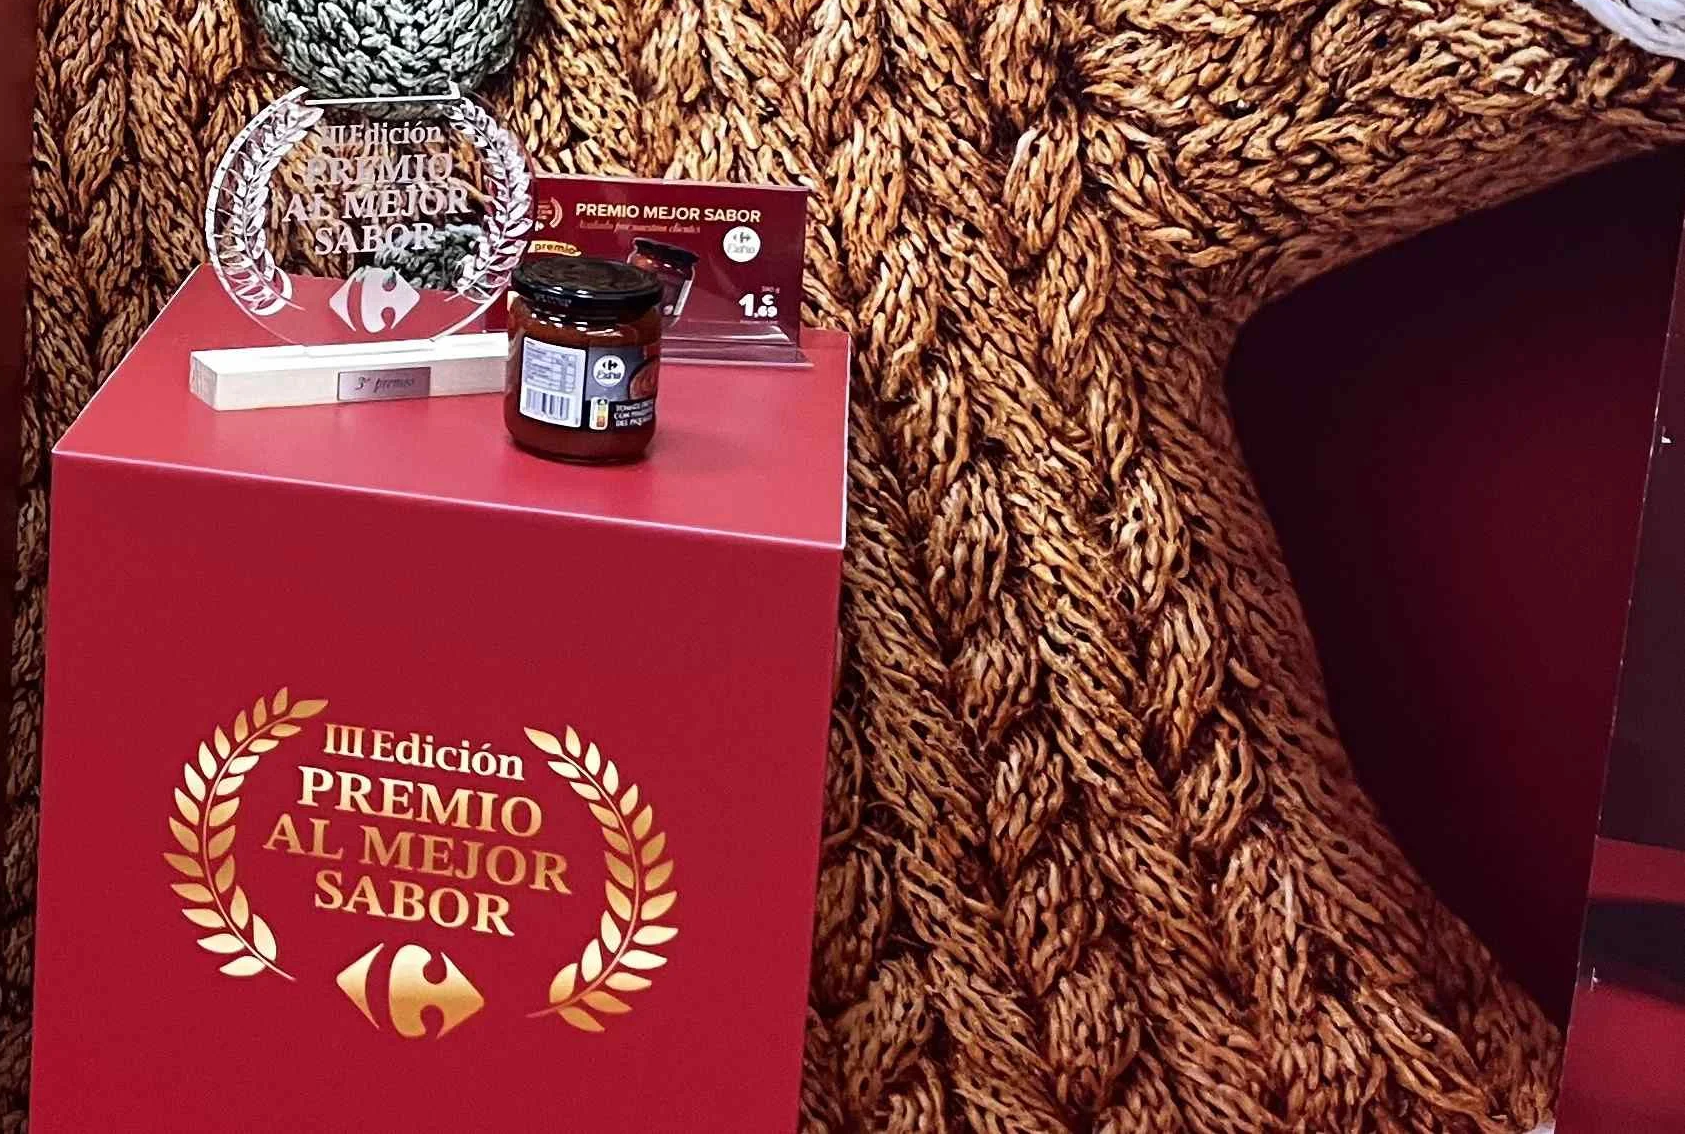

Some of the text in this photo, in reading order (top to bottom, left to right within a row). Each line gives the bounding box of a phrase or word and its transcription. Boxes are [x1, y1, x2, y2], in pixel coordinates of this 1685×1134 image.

[349, 120, 442, 146] Edición
[306, 152, 454, 187] PREMIO
[282, 185, 473, 223] AL MEJOR
[575, 202, 762, 223] PREMIO MEJOR SABOR
[315, 222, 437, 256] SABOR
[534, 241, 577, 255] premio
[323, 722, 525, 781] III Edición
[296, 765, 543, 837] PREMIO
[262, 812, 574, 895] AL MEJOR
[314, 870, 516, 937] SABOR
